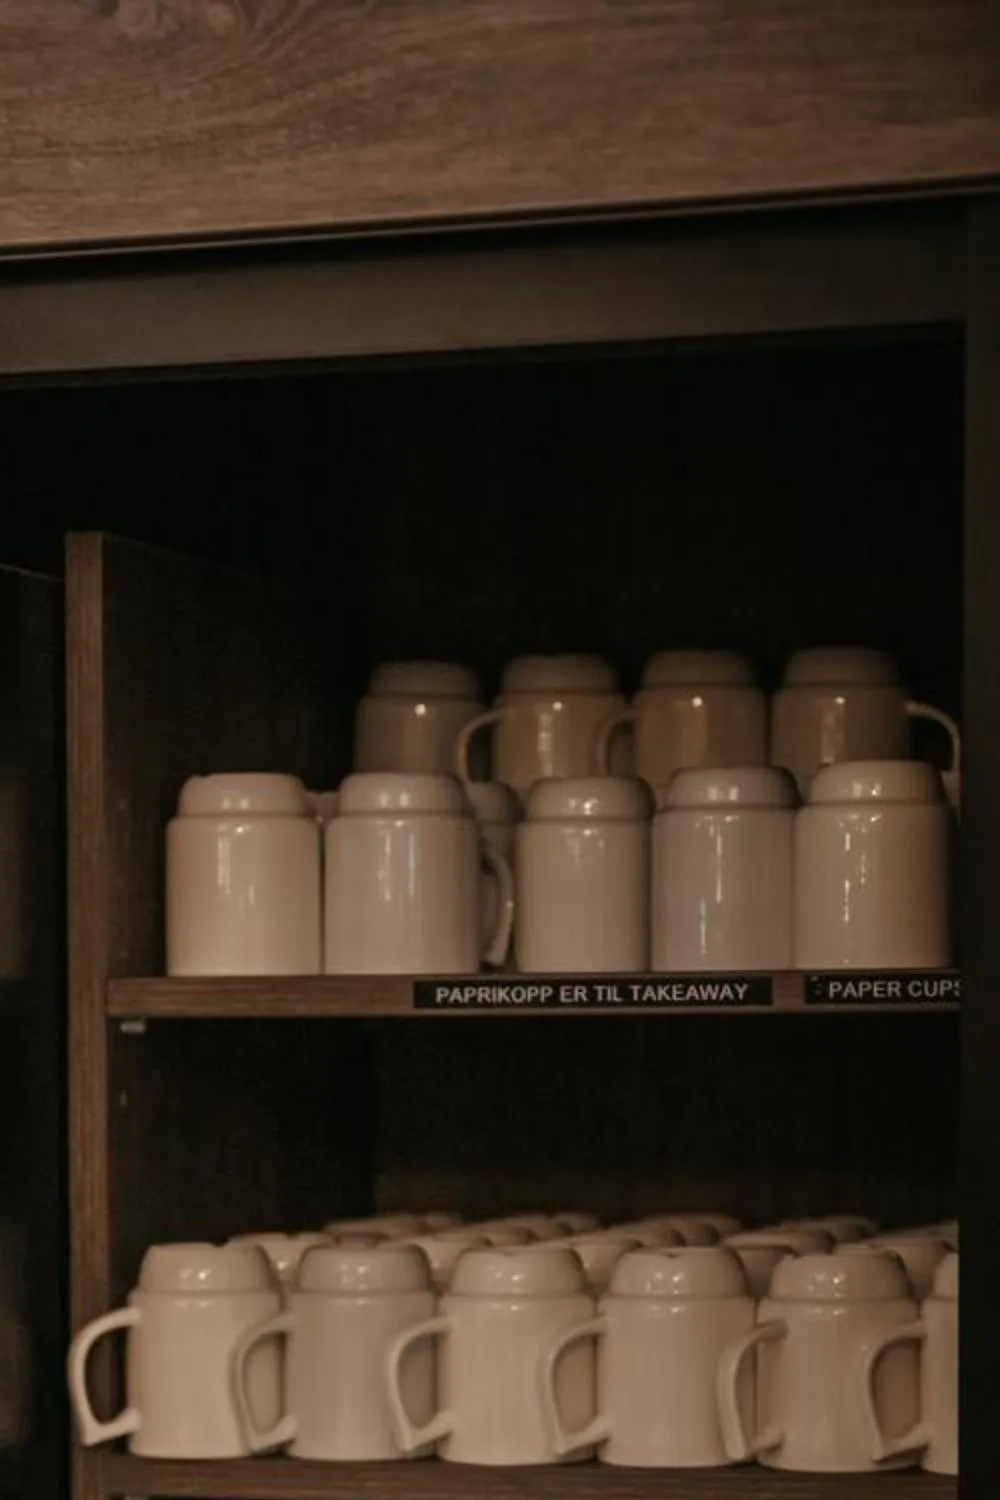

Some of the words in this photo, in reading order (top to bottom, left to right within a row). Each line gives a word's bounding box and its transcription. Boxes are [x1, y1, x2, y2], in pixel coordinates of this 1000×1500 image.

[435, 985, 553, 1003] PAPRIKOPP
[560, 985, 588, 1002] ER
[593, 985, 623, 1002] TIL
[629, 983, 749, 1001] TAKEAWAY
[829, 981, 902, 998] PAPER
